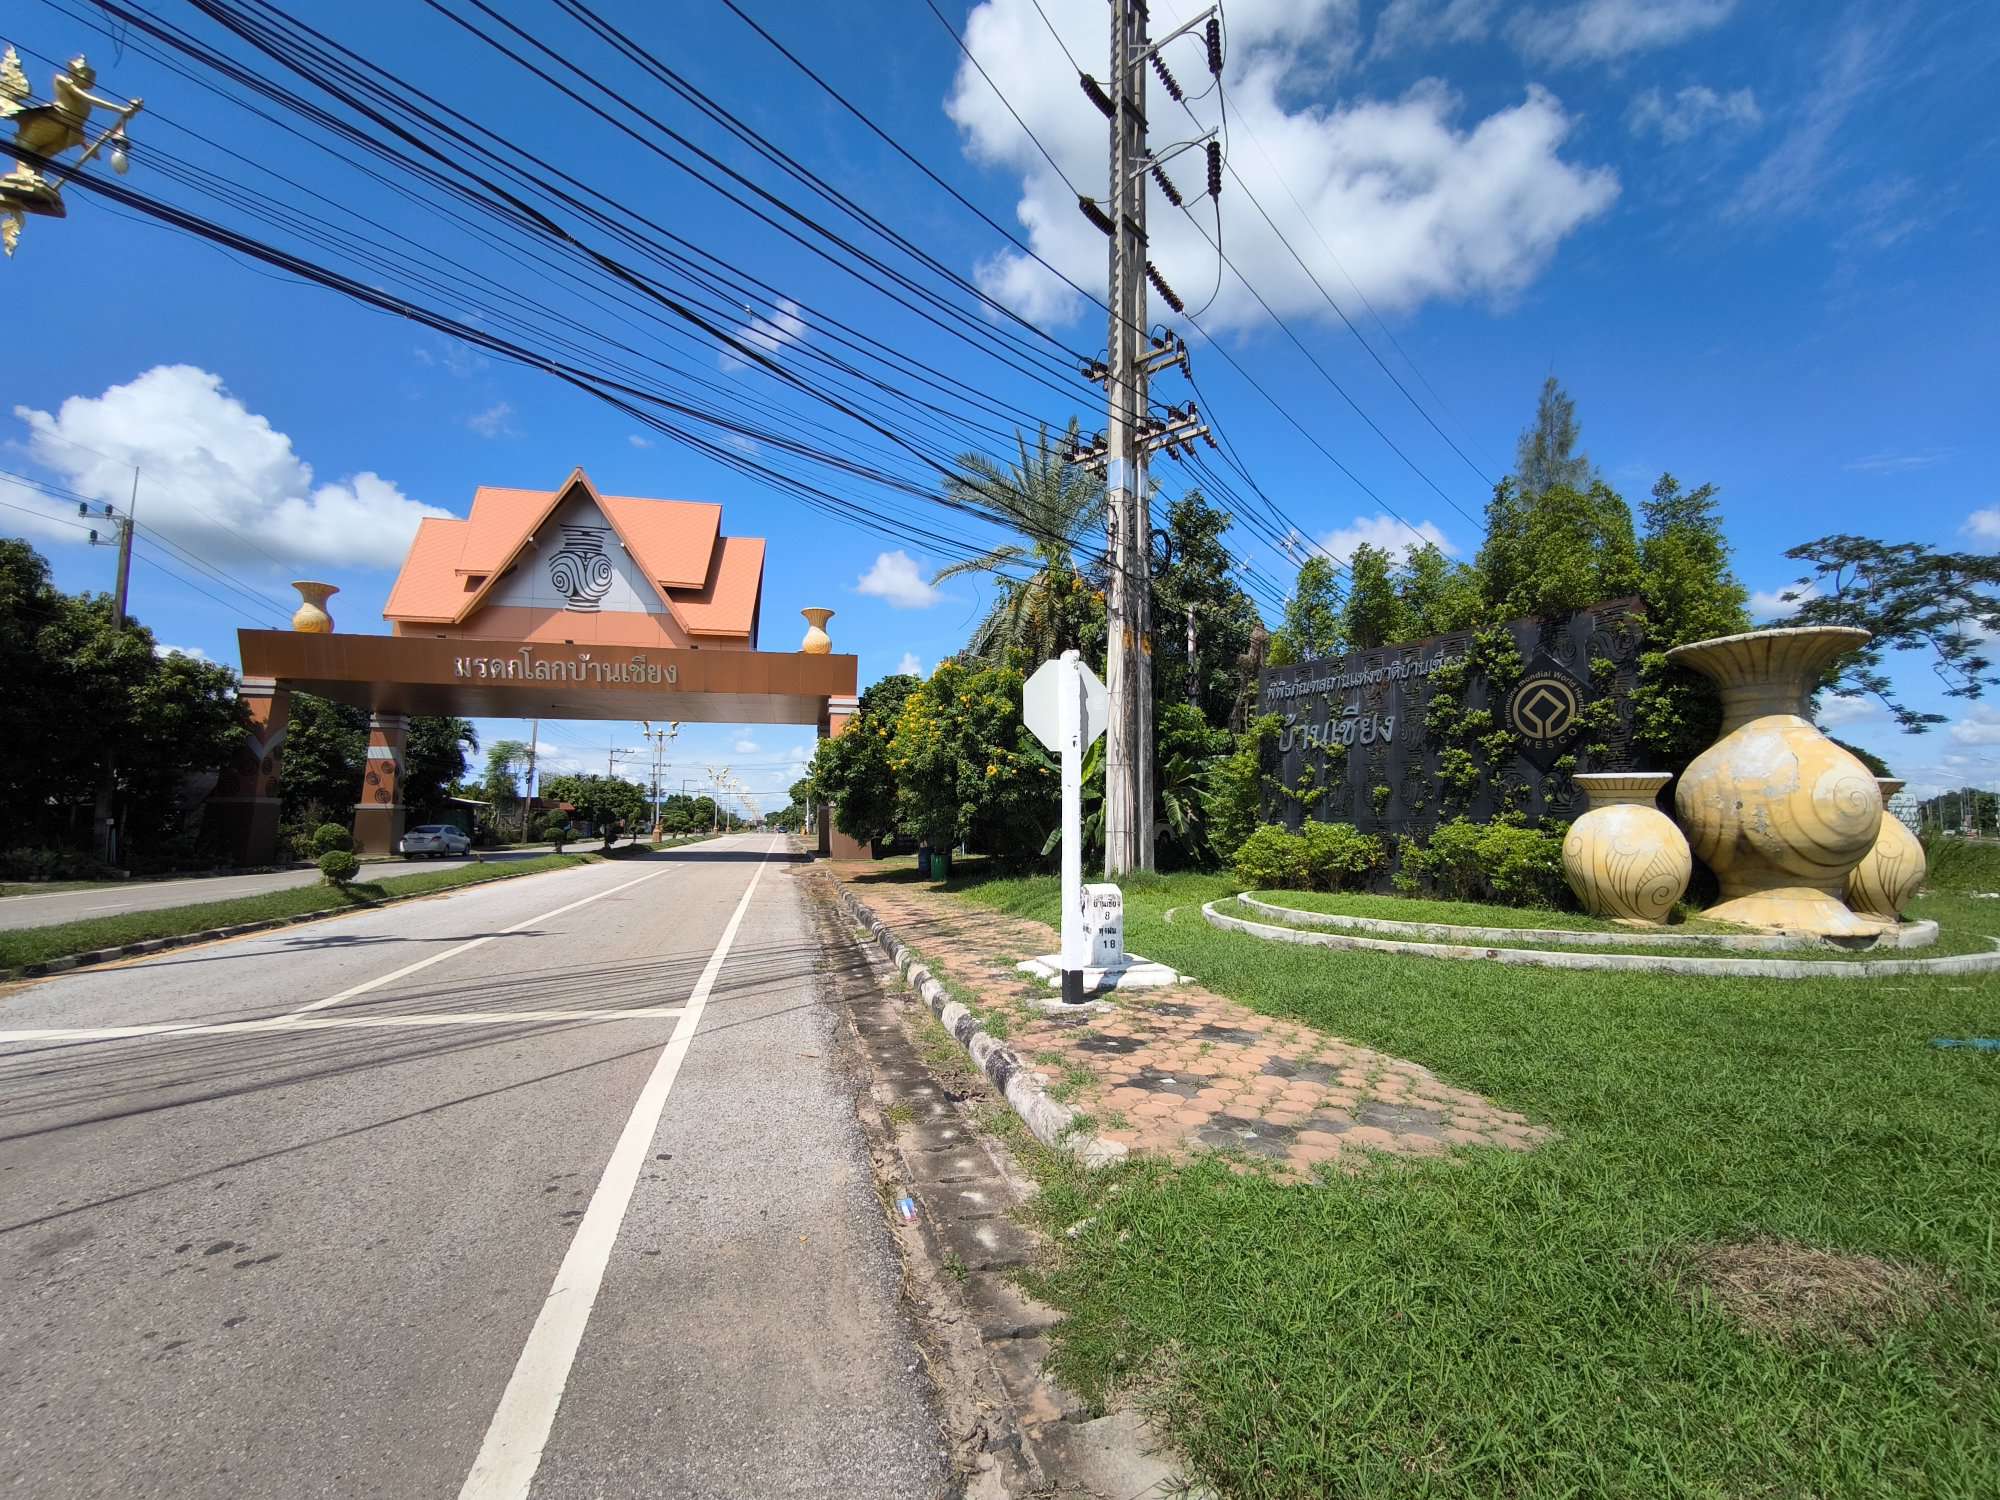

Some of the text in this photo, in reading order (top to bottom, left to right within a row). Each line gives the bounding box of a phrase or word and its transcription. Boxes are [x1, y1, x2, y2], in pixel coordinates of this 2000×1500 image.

[454, 647, 678, 684] มรดกโลกบ้านเชียง
[1553, 671, 1577, 688] World
[1278, 702, 1396, 752] บ้านเชียง
[1104, 911, 1111, 920] 8
